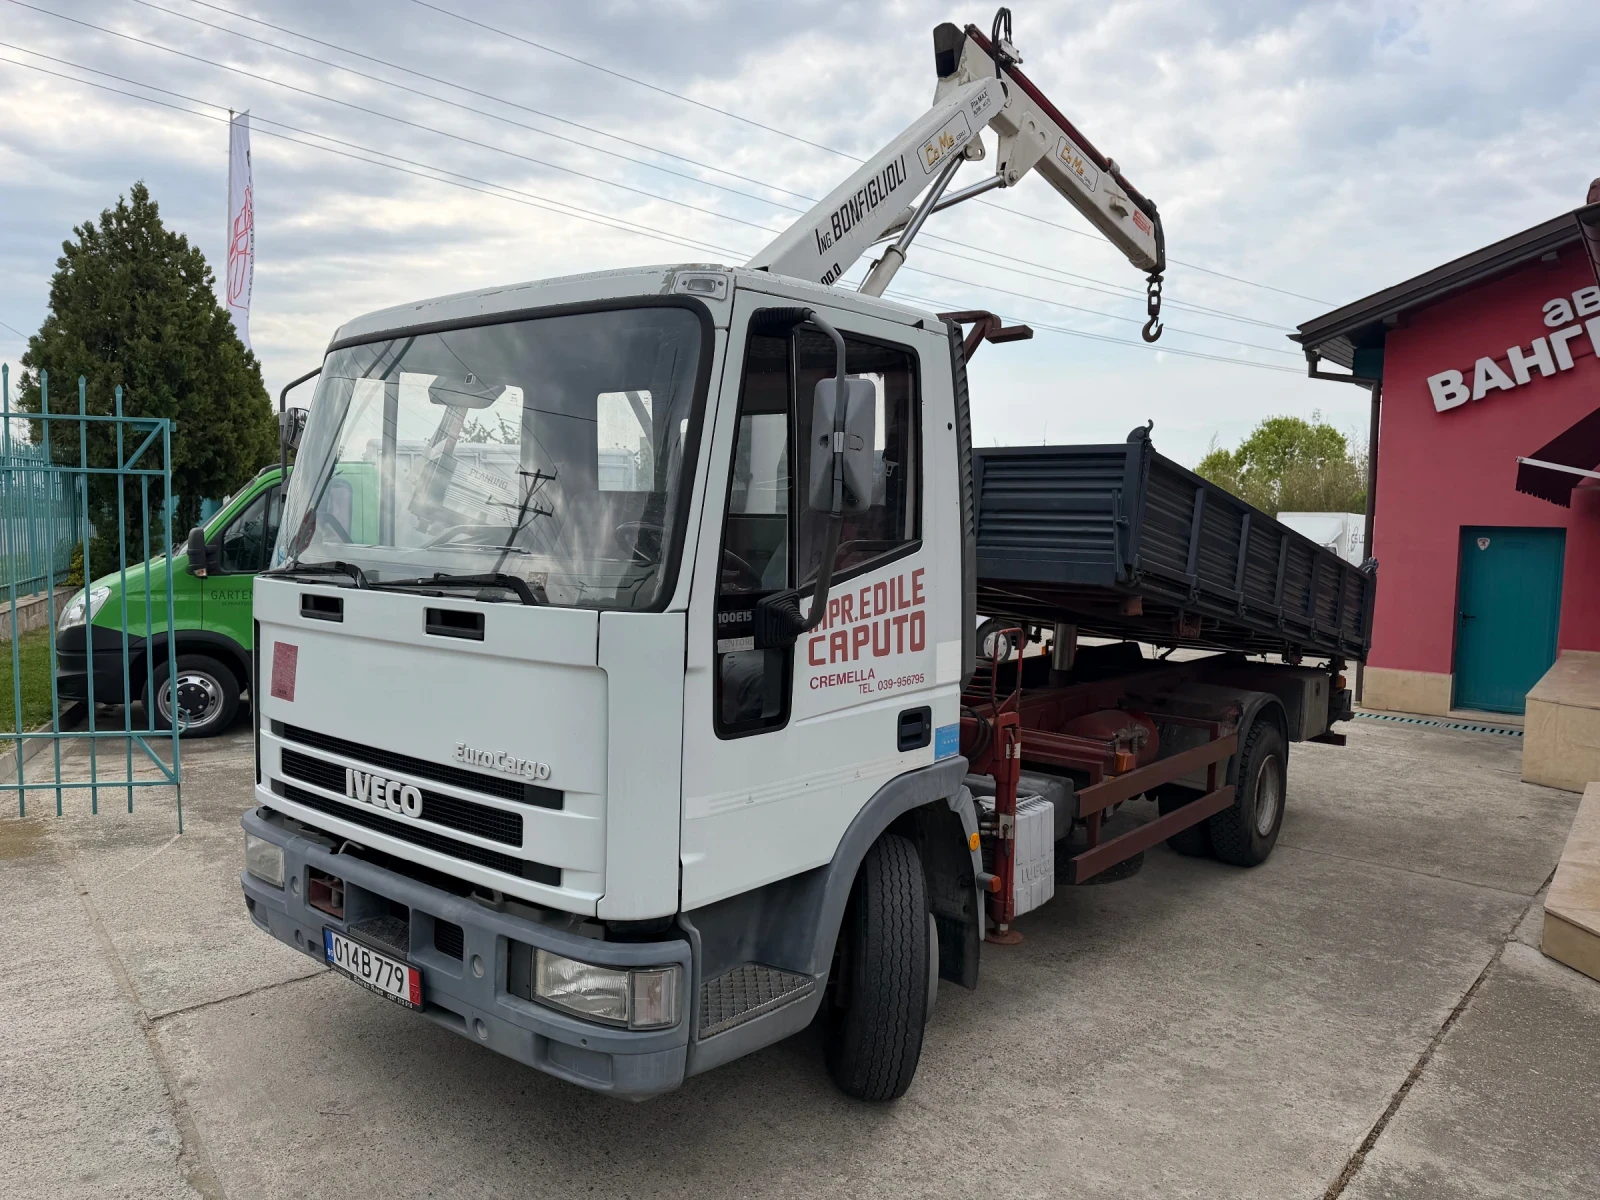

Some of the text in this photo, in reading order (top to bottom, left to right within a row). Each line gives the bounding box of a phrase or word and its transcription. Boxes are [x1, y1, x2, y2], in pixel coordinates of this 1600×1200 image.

[831, 154, 907, 242] BONFIGLIOLI
[718, 611, 753, 624] 100E15
[808, 610, 926, 667] CAPUTO
[809, 668, 876, 690] CREMELLA
[858, 673, 925, 694] TEL. 039-956795
[453, 741, 551, 780] EuroCargo
[345, 768, 423, 818] IVECO
